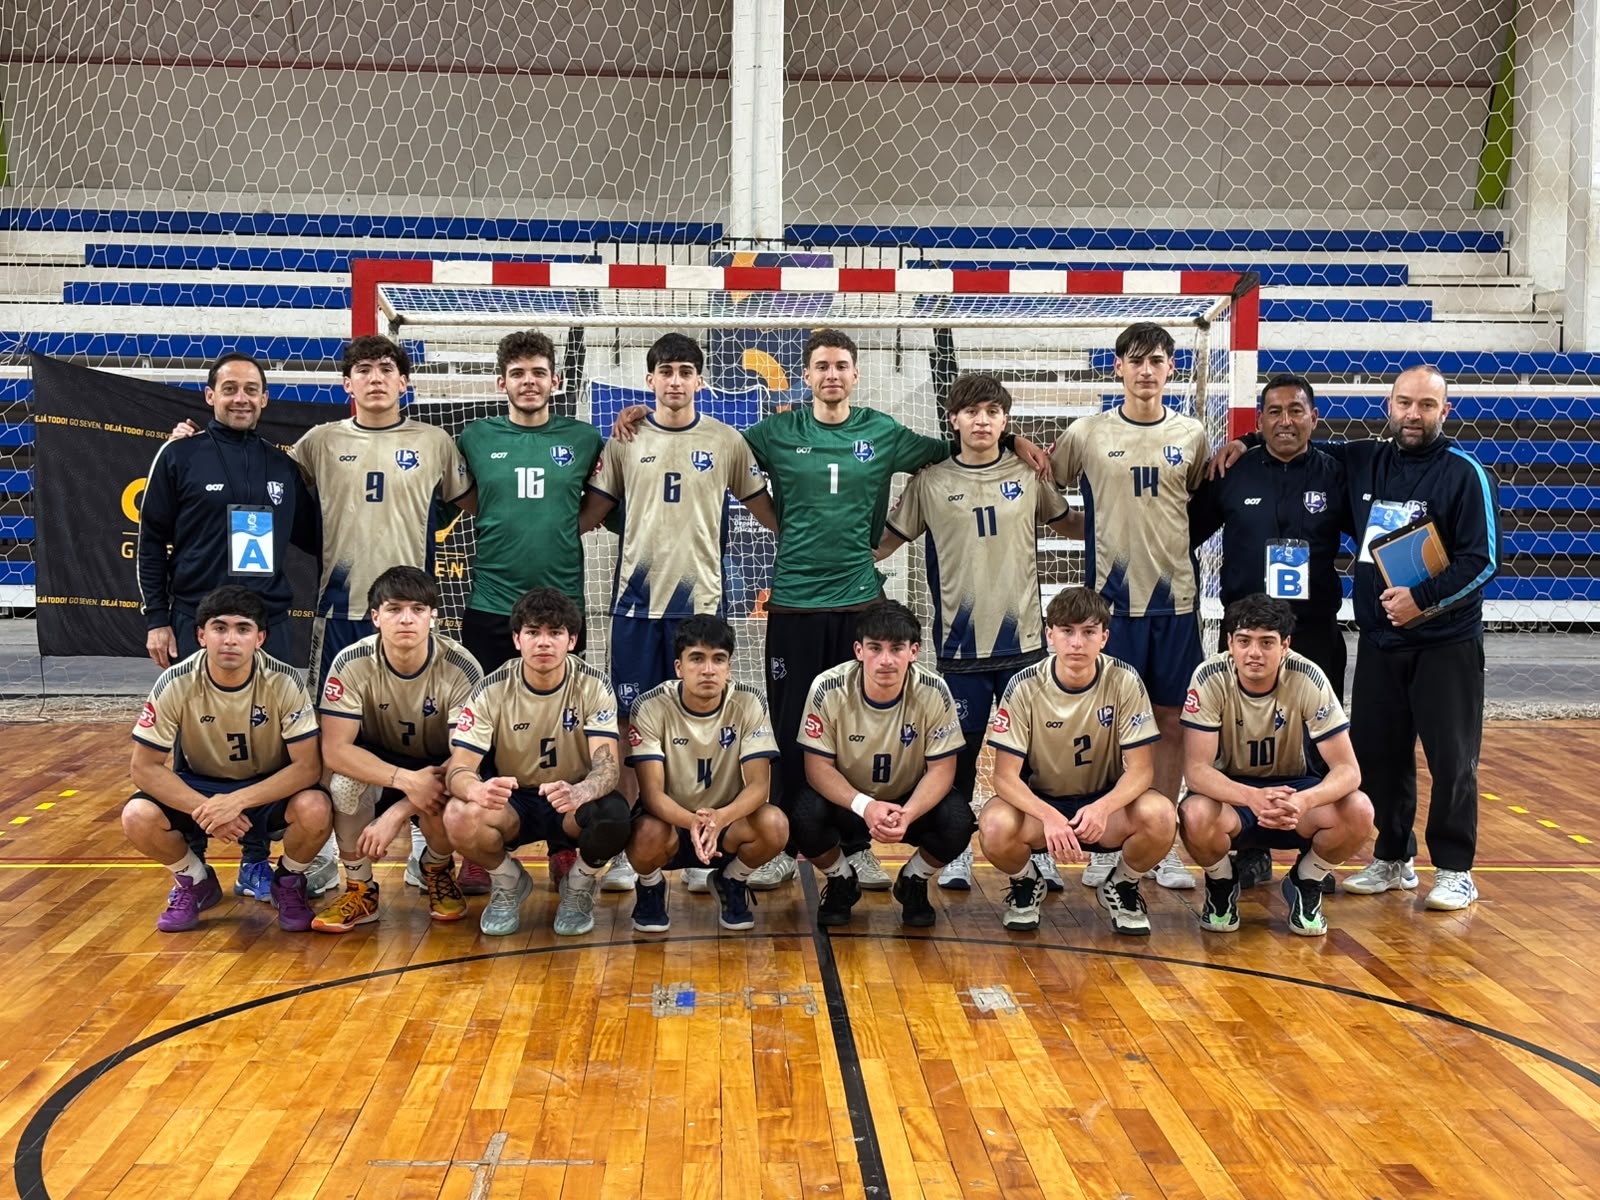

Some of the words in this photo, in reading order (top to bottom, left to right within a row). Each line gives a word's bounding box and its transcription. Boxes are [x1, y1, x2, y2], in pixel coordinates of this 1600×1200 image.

[34, 413, 47, 423] EJÁ
[48, 416, 68, 425] TODO!
[104, 423, 122, 433] DEJÁ
[123, 427, 144, 436] TODO!
[145, 429, 155, 437] GO
[366, 472, 384, 503] 9
[514, 467, 545, 498] 16
[663, 472, 681, 503] 6
[827, 463, 839, 494] 1
[1130, 467, 1159, 497] 14
[972, 506, 997, 537] 11
[237, 539, 270, 569] A
[1277, 569, 1302, 596] B
[37, 595, 47, 603] EJÁ
[100, 597, 118, 607] DEJÁ
[119, 600, 139, 608] TODO!
[227, 733, 249, 761] 3
[540, 738, 557, 768] 5
[672, 737, 689, 746] GO7
[1073, 734, 1092, 766] 2
[1247, 737, 1275, 767] 10
[697, 759, 712, 789] 4
[872, 754, 891, 783] 8
